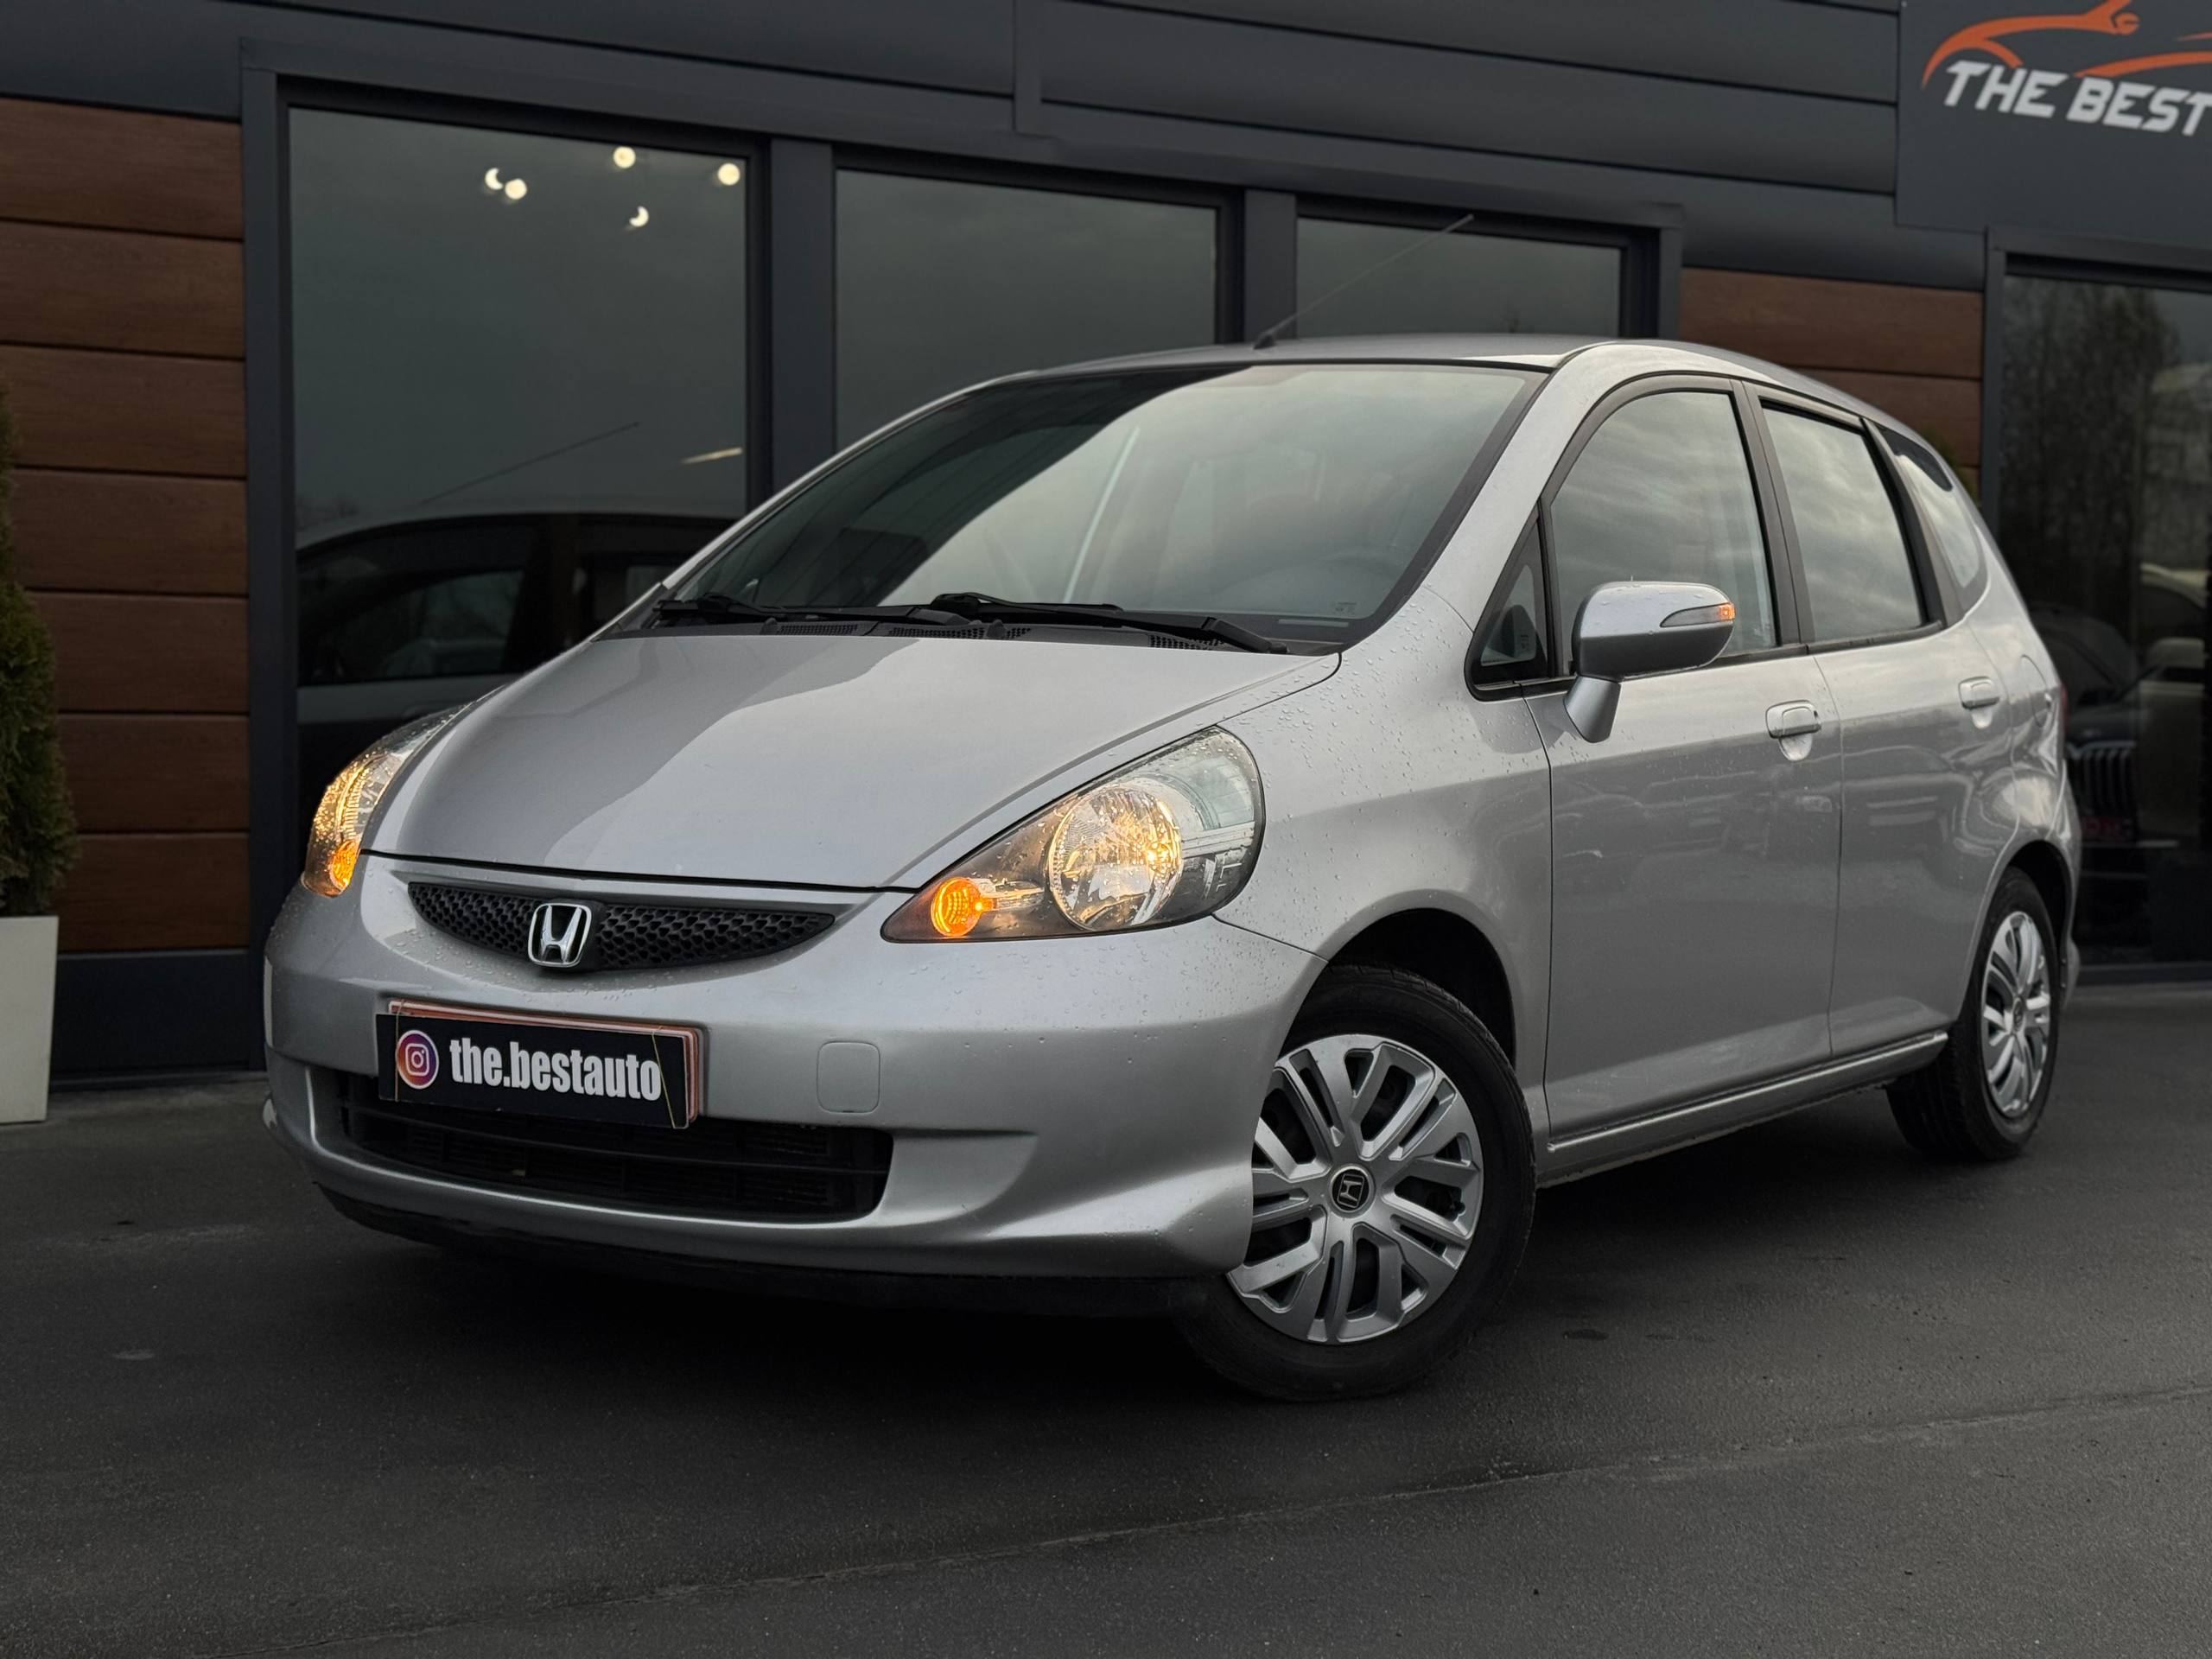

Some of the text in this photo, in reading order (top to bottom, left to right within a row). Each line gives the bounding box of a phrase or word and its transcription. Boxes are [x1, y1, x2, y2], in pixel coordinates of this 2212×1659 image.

[1944, 60, 2212, 136] THE BEST
[448, 1037, 662, 1102] the.bestauto
